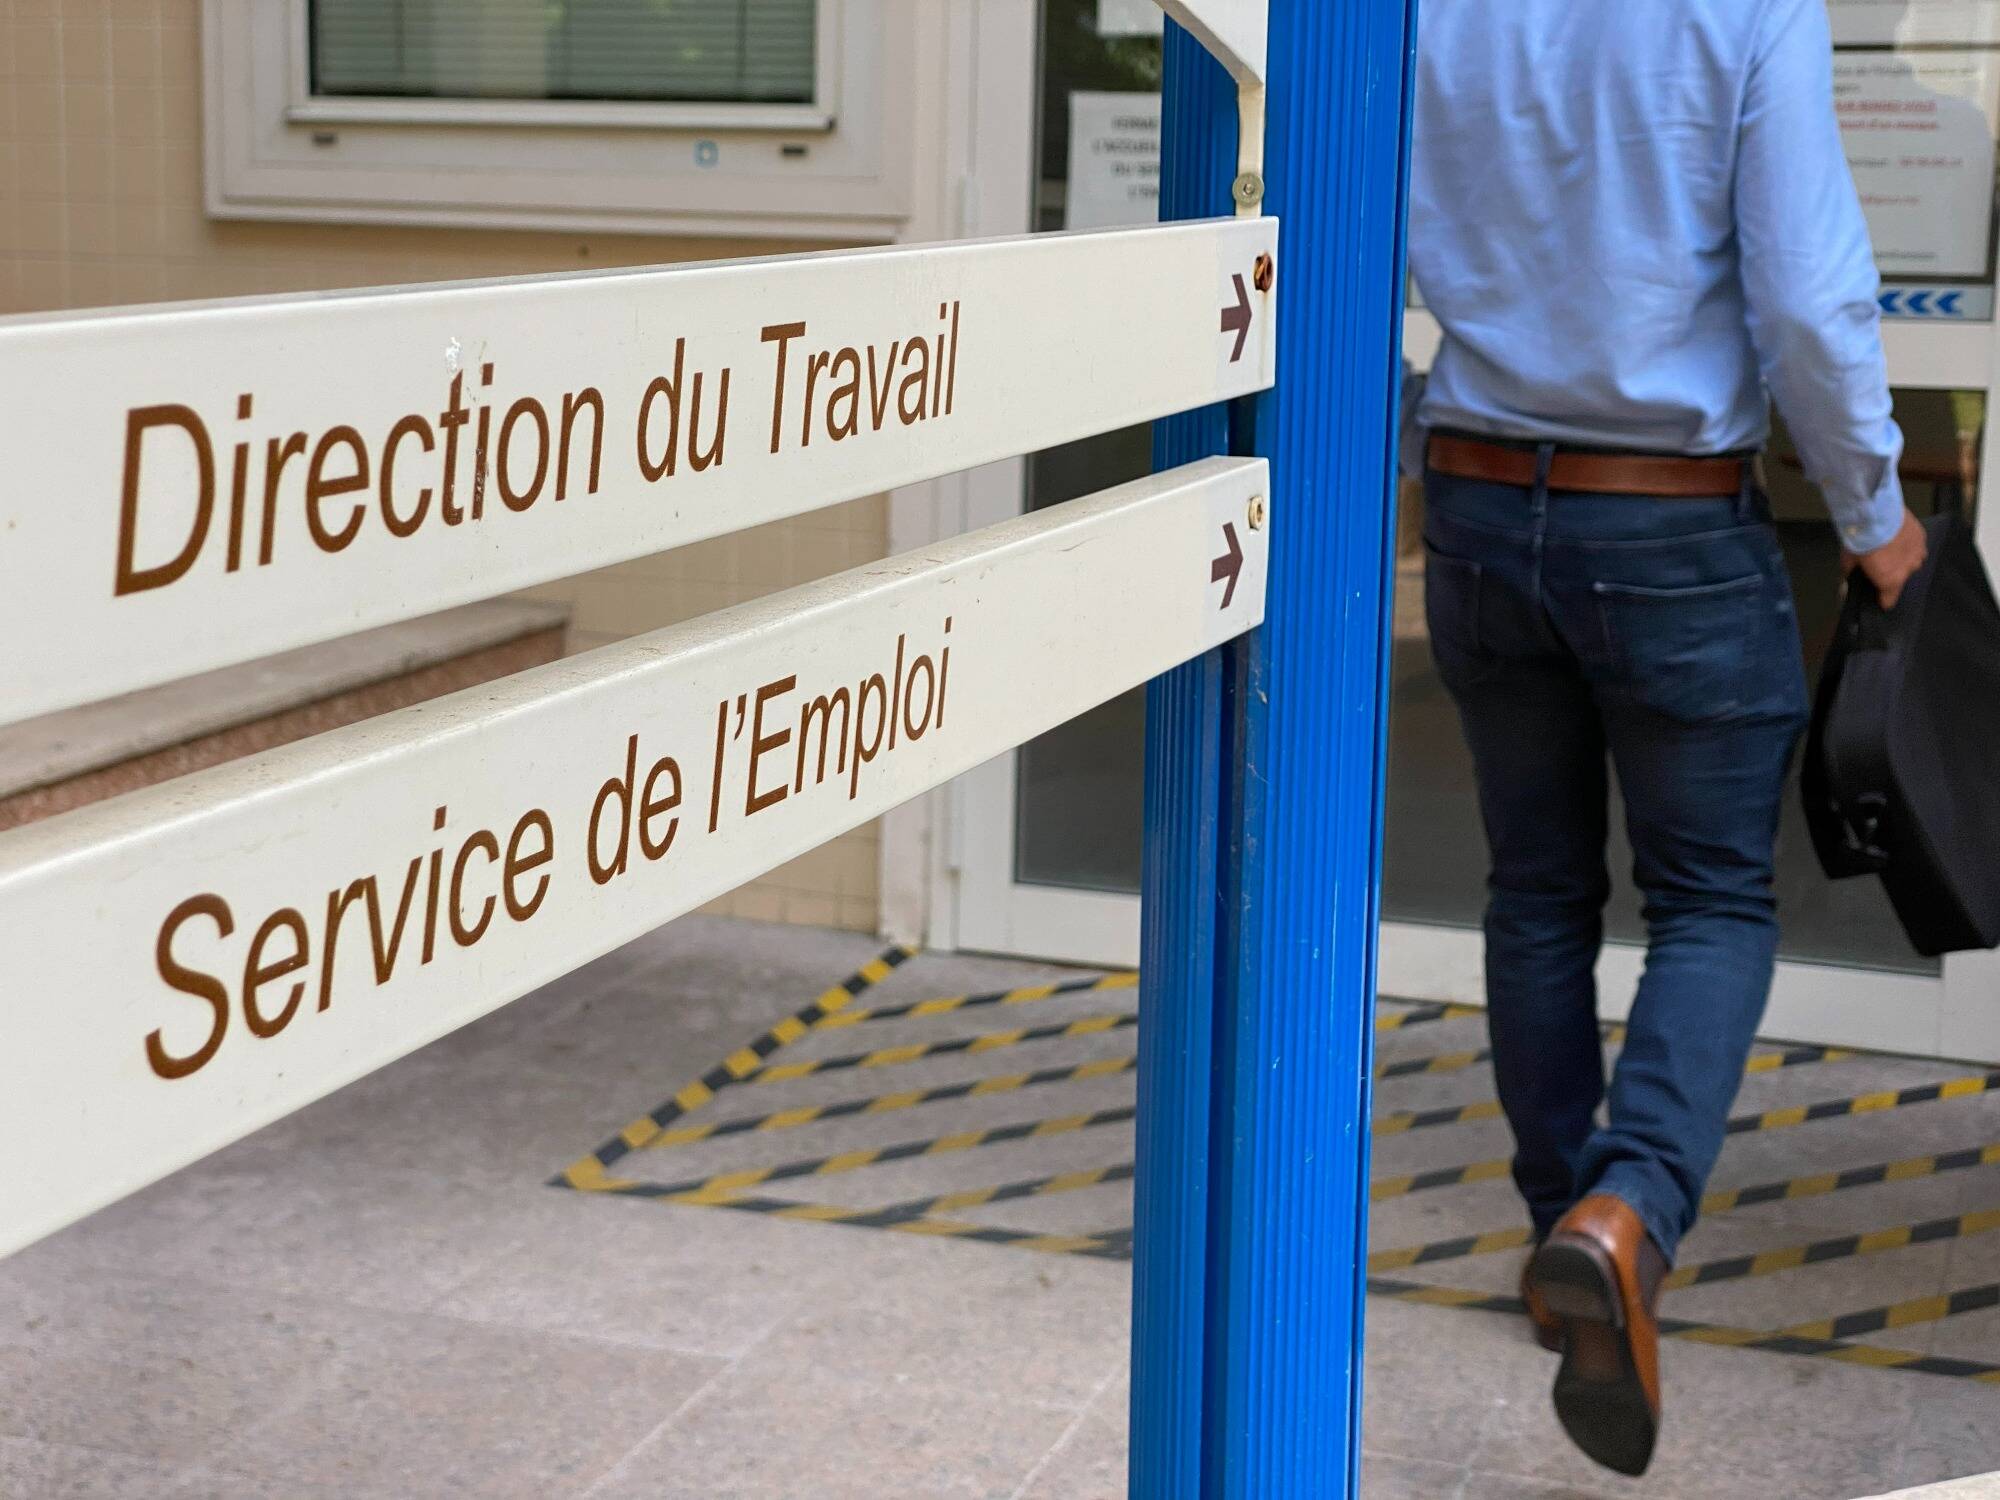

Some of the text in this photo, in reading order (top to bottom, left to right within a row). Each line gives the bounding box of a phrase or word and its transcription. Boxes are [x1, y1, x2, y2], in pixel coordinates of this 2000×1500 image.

[113, 301, 960, 597] Direction du Travail
[145, 616, 952, 1080] Service de l’Emploi
